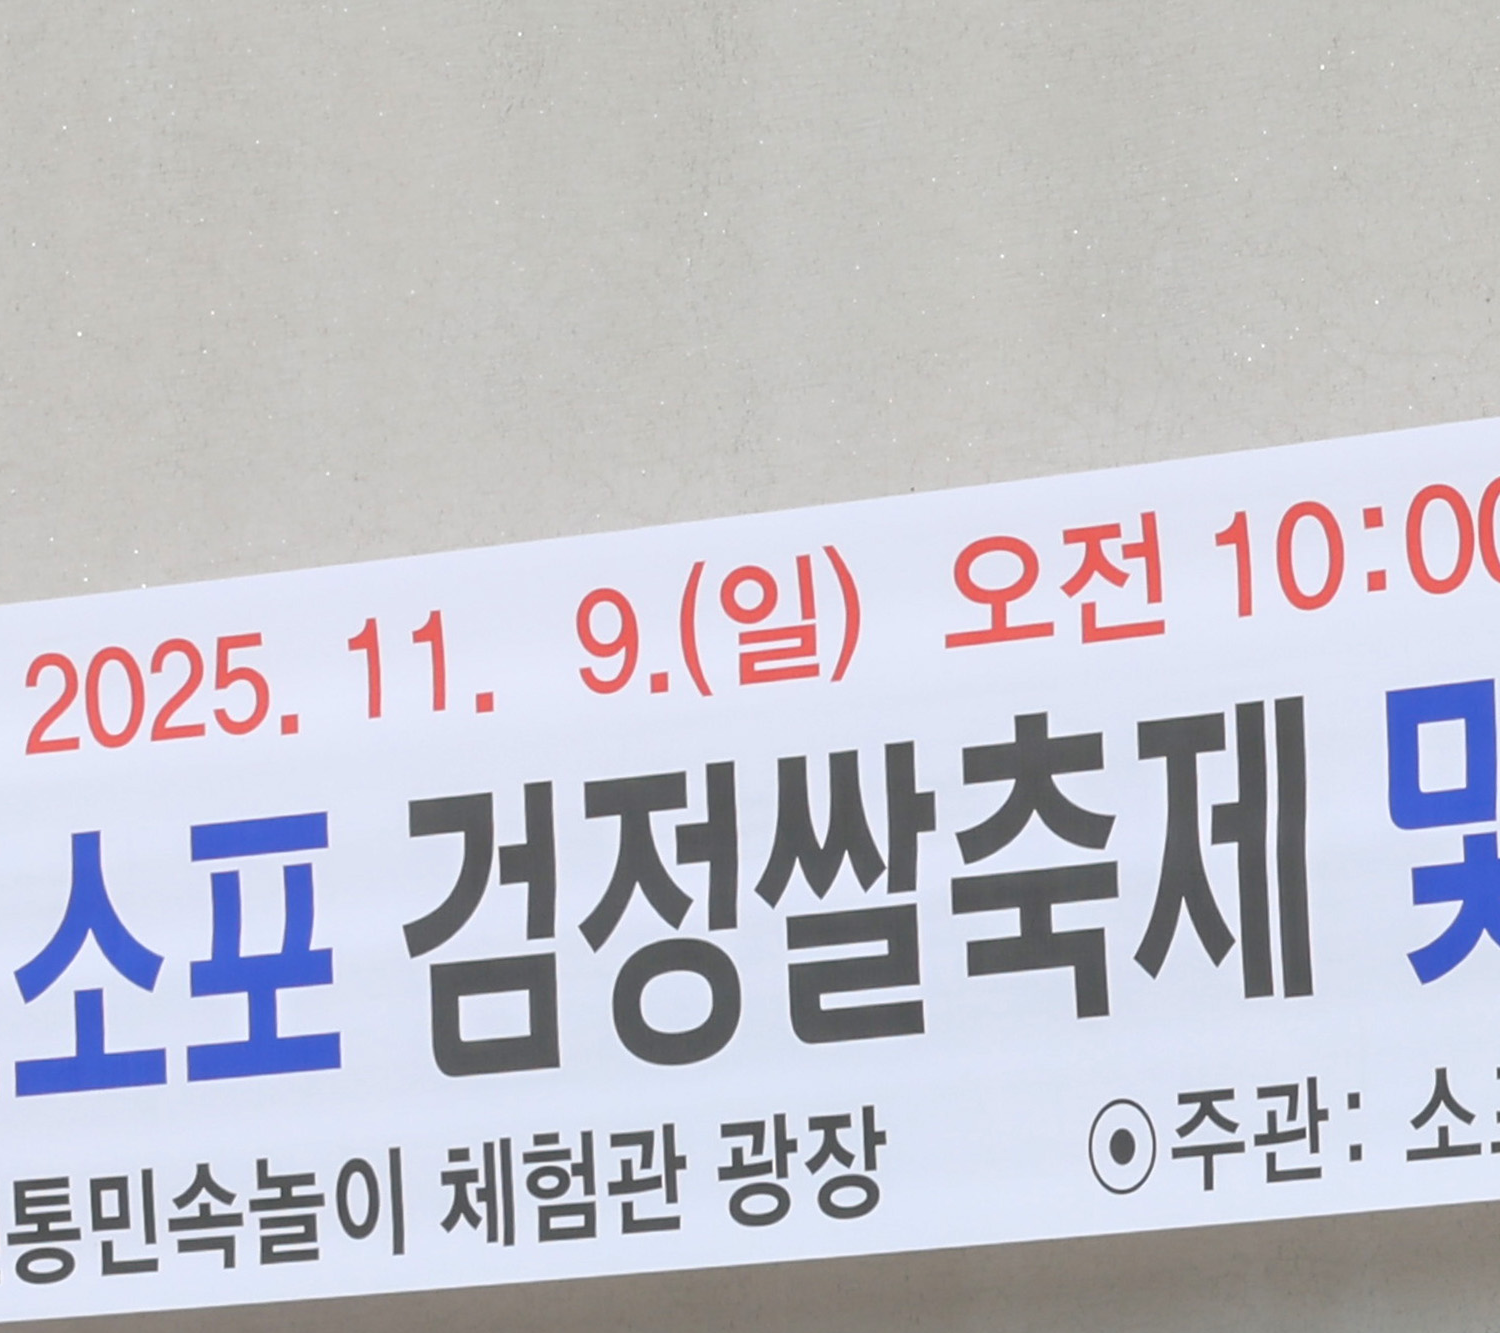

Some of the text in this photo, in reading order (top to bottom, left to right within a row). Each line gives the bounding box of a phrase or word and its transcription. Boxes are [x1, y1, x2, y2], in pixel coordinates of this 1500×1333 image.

[26, 633, 298, 754] 2025.
[349, 610, 494, 718] 11.
[577, 546, 860, 696] 9.(일)
[946, 512, 1165, 648] 오전
[403, 696, 1313, 1076] 검정쌀축제
[441, 1124, 686, 1246] 체험관
[718, 1106, 886, 1226] 광장
[1172, 1077, 1362, 1191] 주관:
